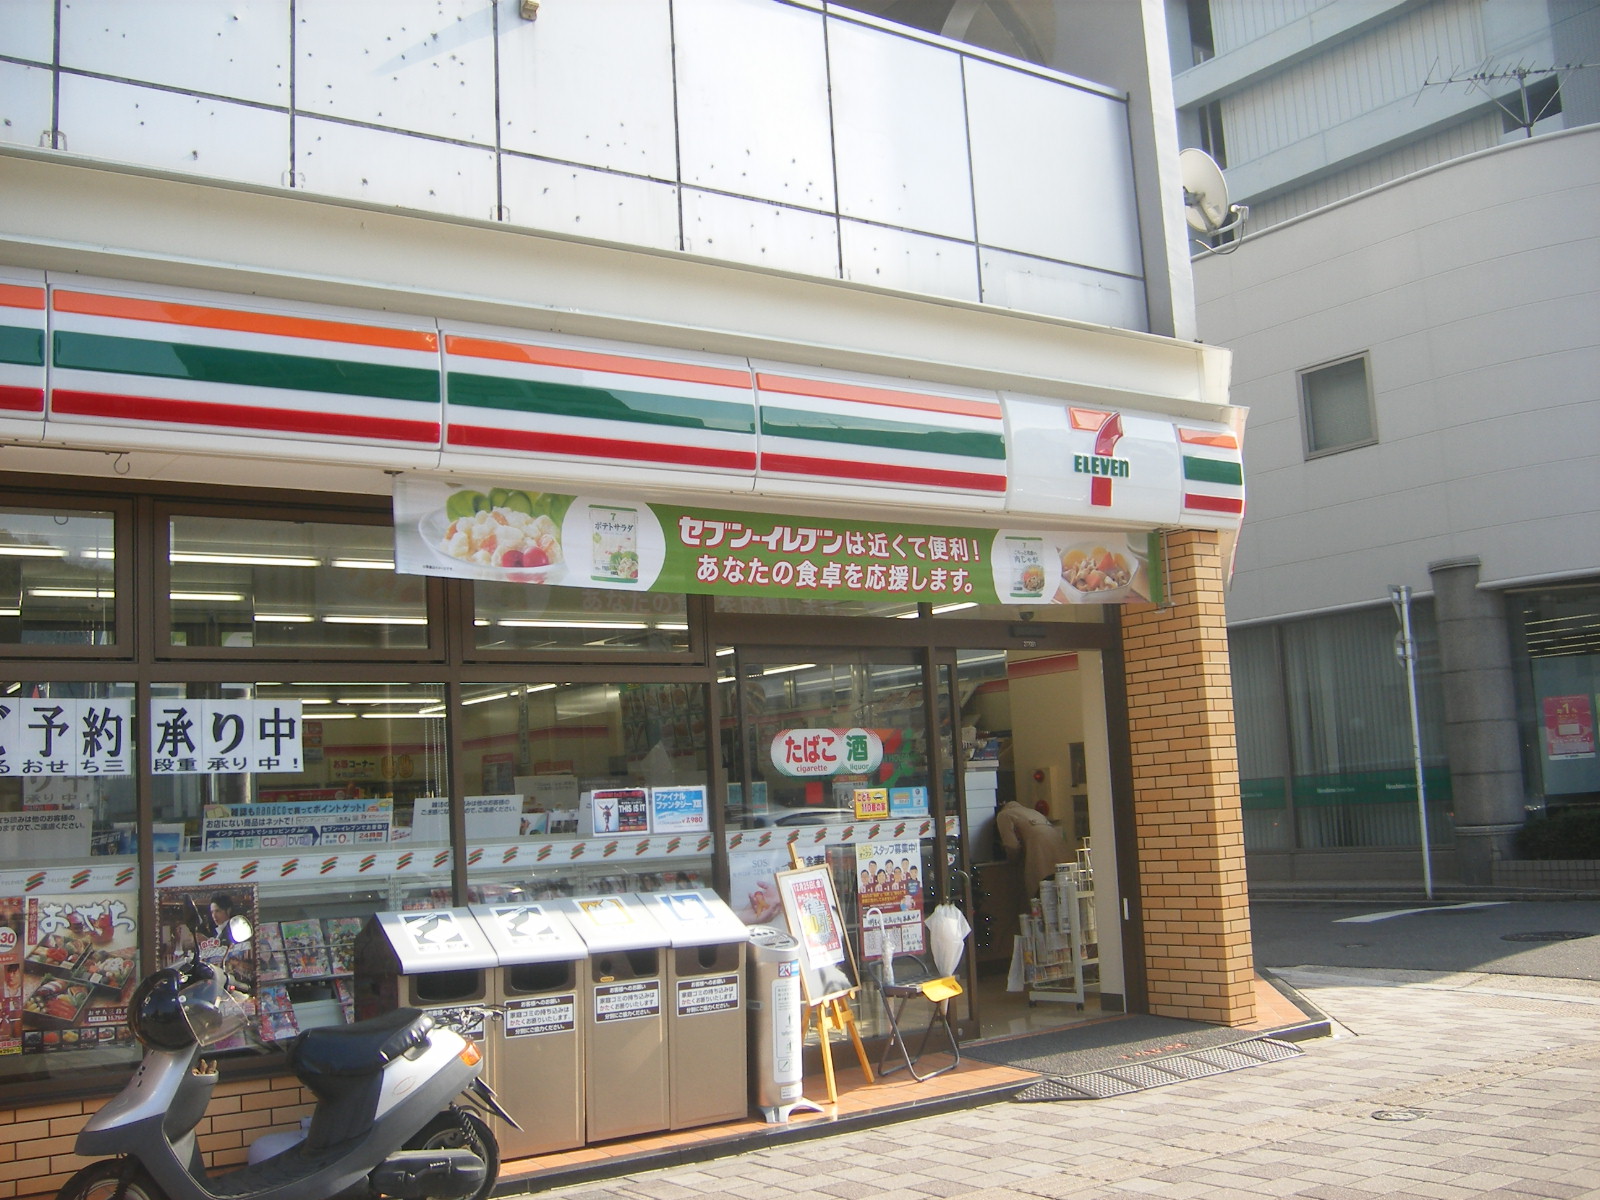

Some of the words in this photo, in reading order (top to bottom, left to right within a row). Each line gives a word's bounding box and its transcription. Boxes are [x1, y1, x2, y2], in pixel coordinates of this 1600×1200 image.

[595, 522, 633, 532] ポテトサラダ
[696, 554, 972, 594] あなたの食卓を応援します。
[785, 733, 837, 763] たばこ
[846, 734, 868, 762] 酒
[796, 764, 828, 772] cigarette
[850, 763, 869, 771] liquor
[655, 792, 686, 801] ファイナル
[619, 805, 632, 813] THIS
[656, 801, 692, 809] ファンタジー
[209, 839, 219, 849] 本
[262, 836, 278, 847] CD
[873, 842, 918, 856] スタッフ募集中!
[41, 900, 136, 934] おせち
